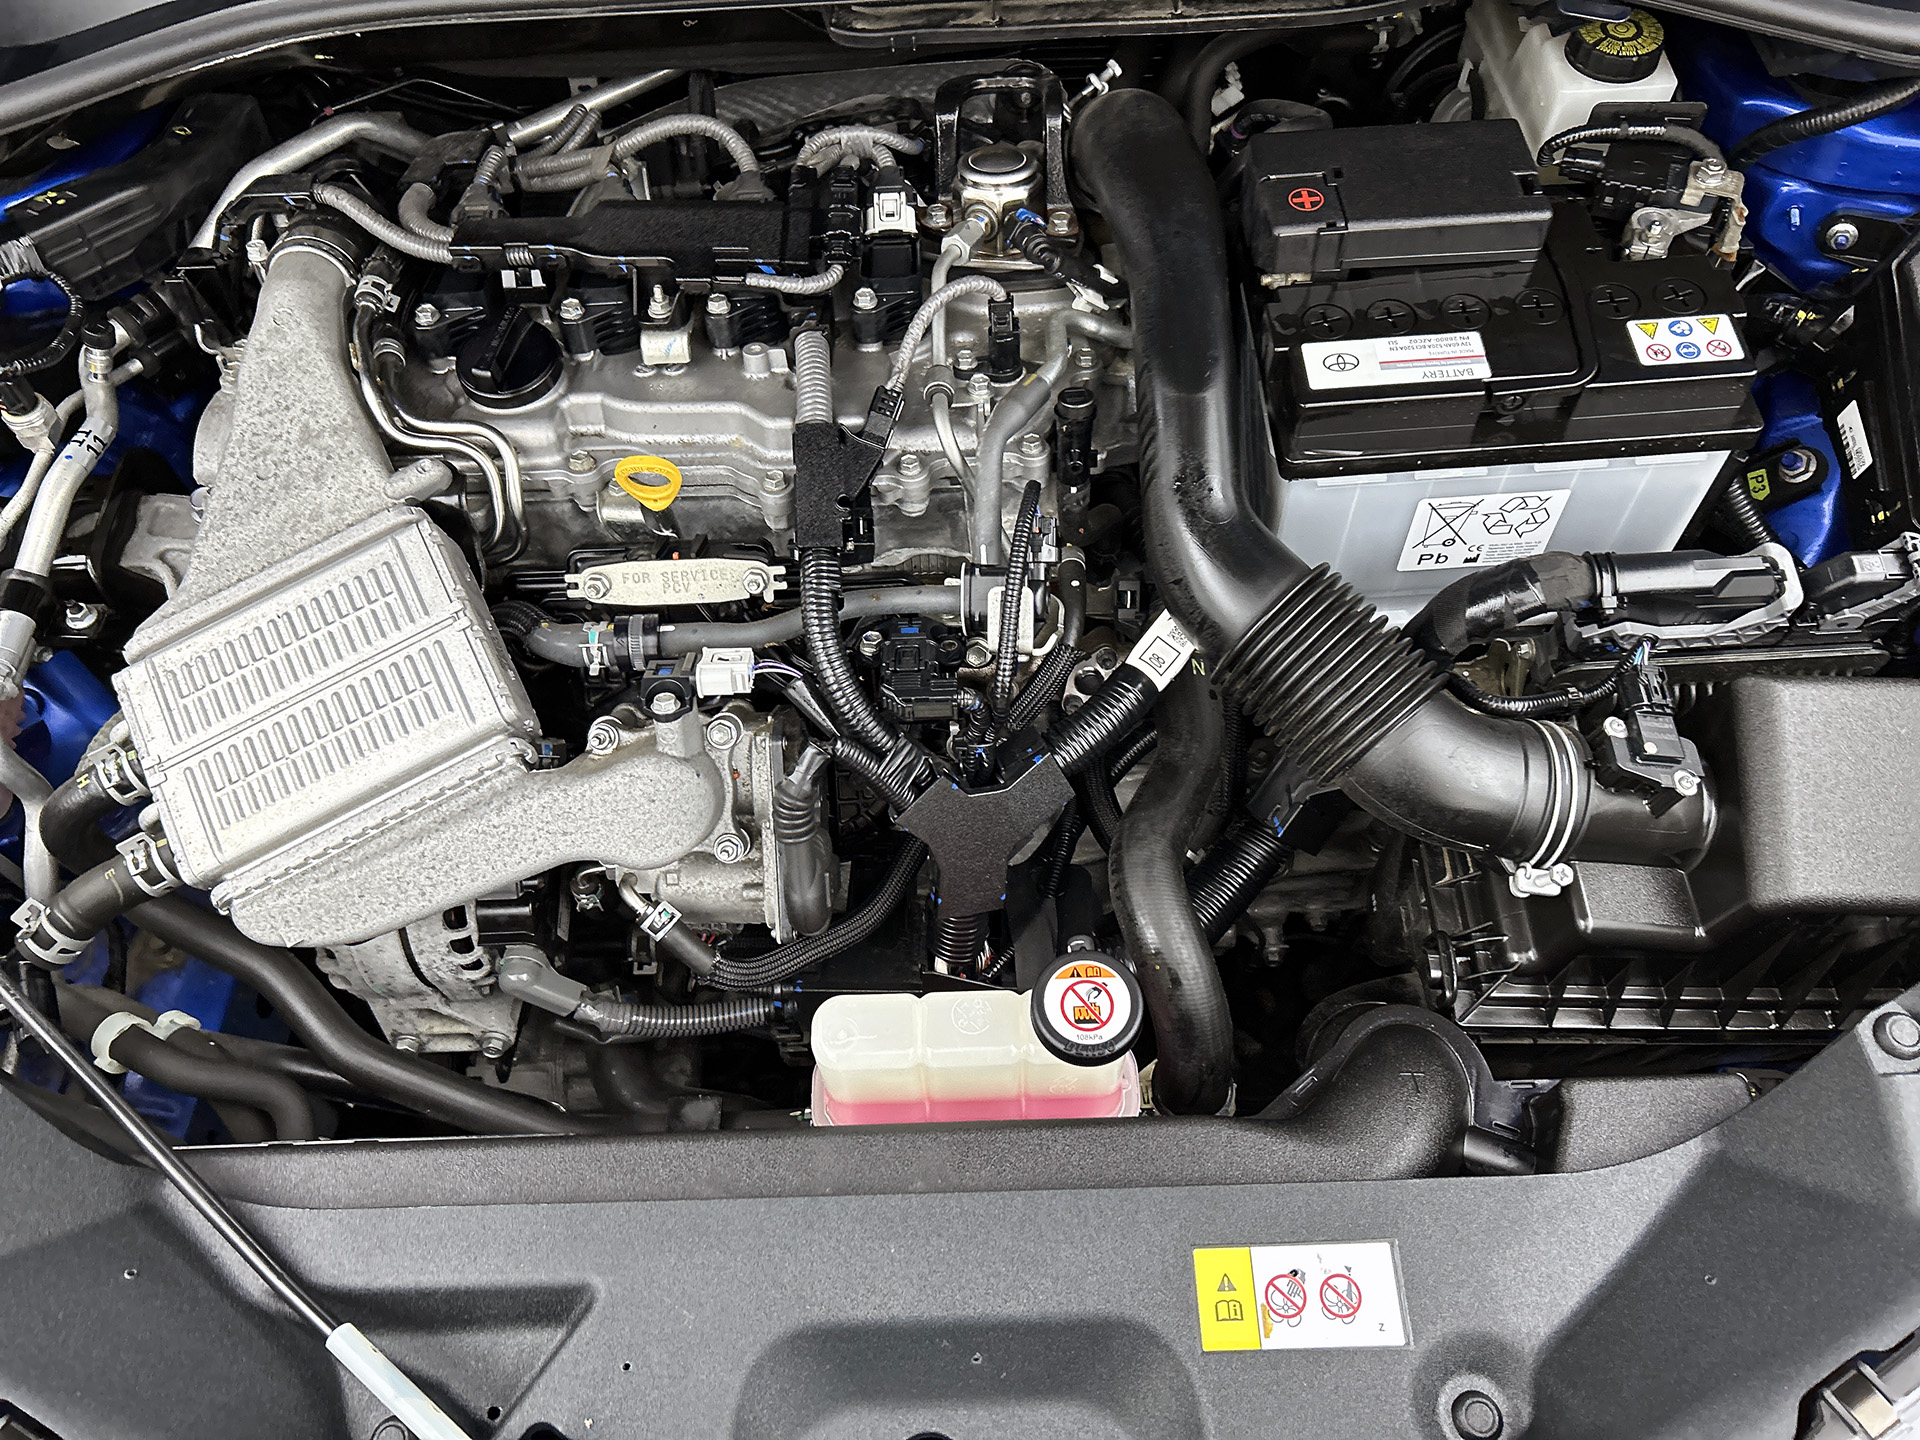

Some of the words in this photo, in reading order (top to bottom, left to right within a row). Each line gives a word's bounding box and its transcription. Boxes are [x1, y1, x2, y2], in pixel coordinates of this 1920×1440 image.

[1422, 368, 1475, 379] BATTERY
[86, 434, 108, 460] 11
[1749, 474, 1767, 494] P3
[1416, 553, 1449, 565] Pb
[621, 572, 651, 584] FOR
[662, 569, 730, 583] SERVICE
[662, 582, 691, 594] PCV
[1191, 658, 1206, 676] N
[1075, 1033, 1103, 1041] 108kPa
[1378, 1322, 1386, 1332] Z
